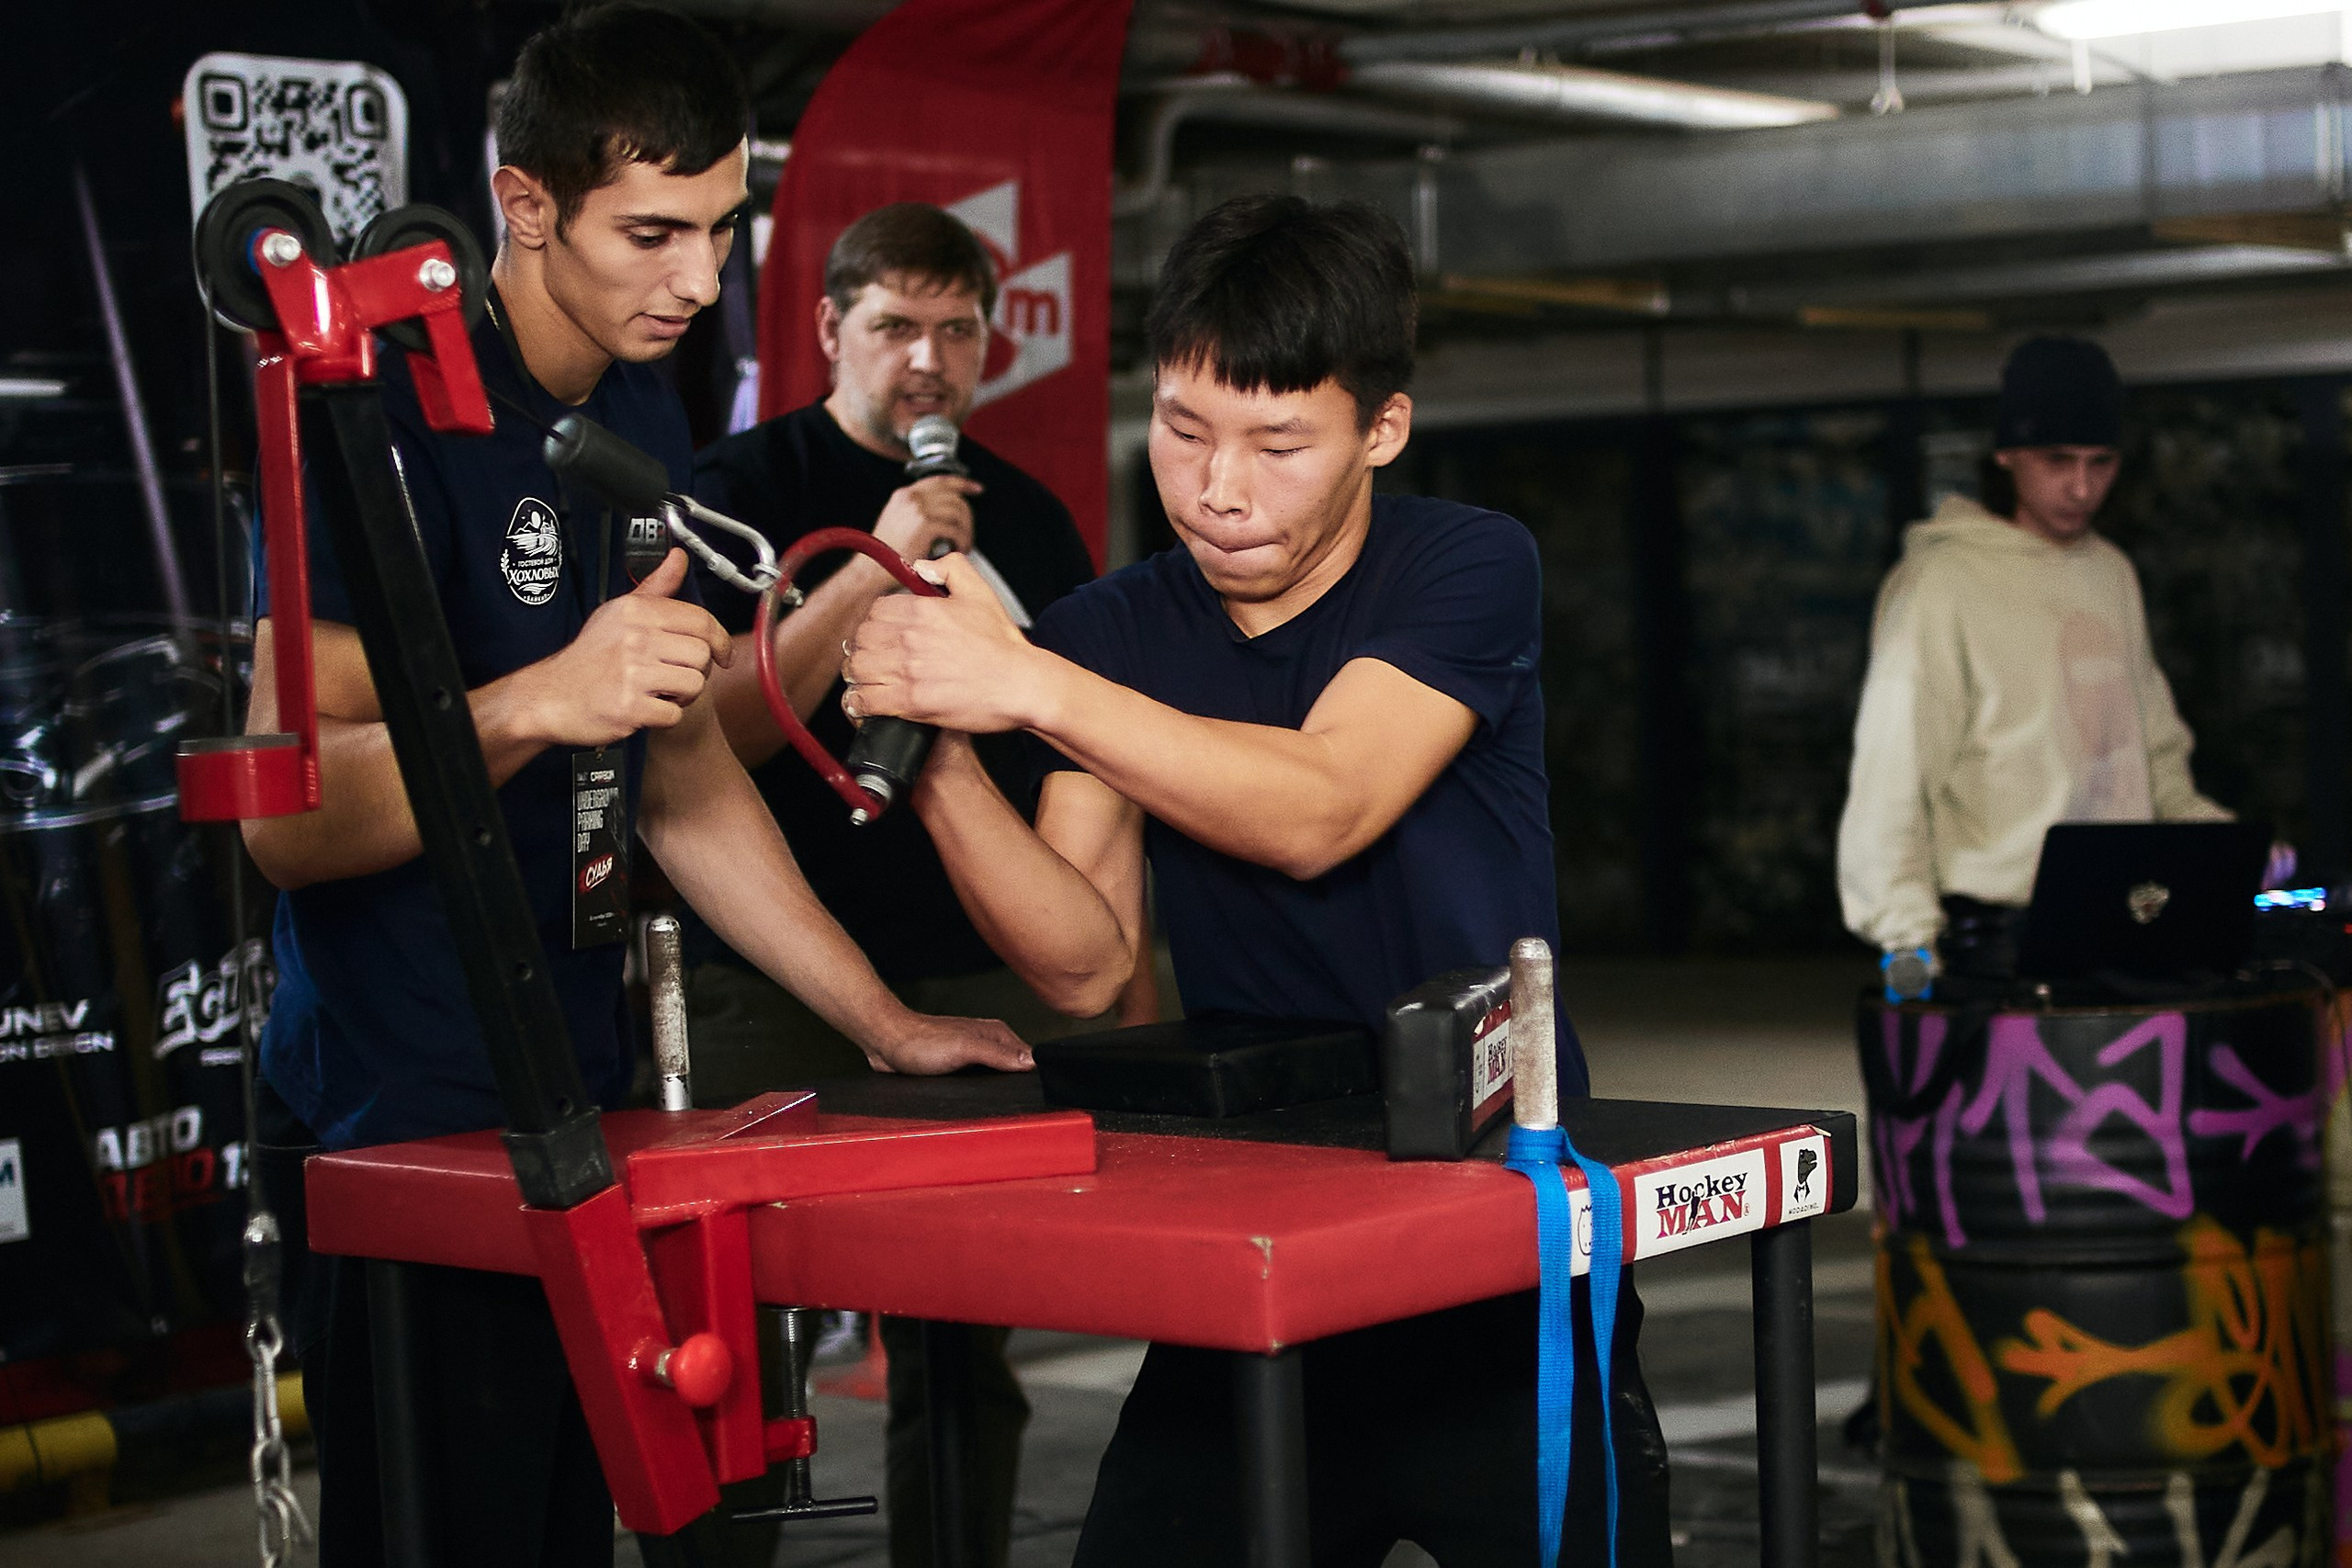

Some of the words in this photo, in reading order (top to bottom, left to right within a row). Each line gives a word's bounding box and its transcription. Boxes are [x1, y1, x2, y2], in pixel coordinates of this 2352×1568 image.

[585, 856, 613, 887] СУДЬЯ
[96, 1104, 204, 1170] АВТО
[1655, 1172, 1747, 1210] Hockey
